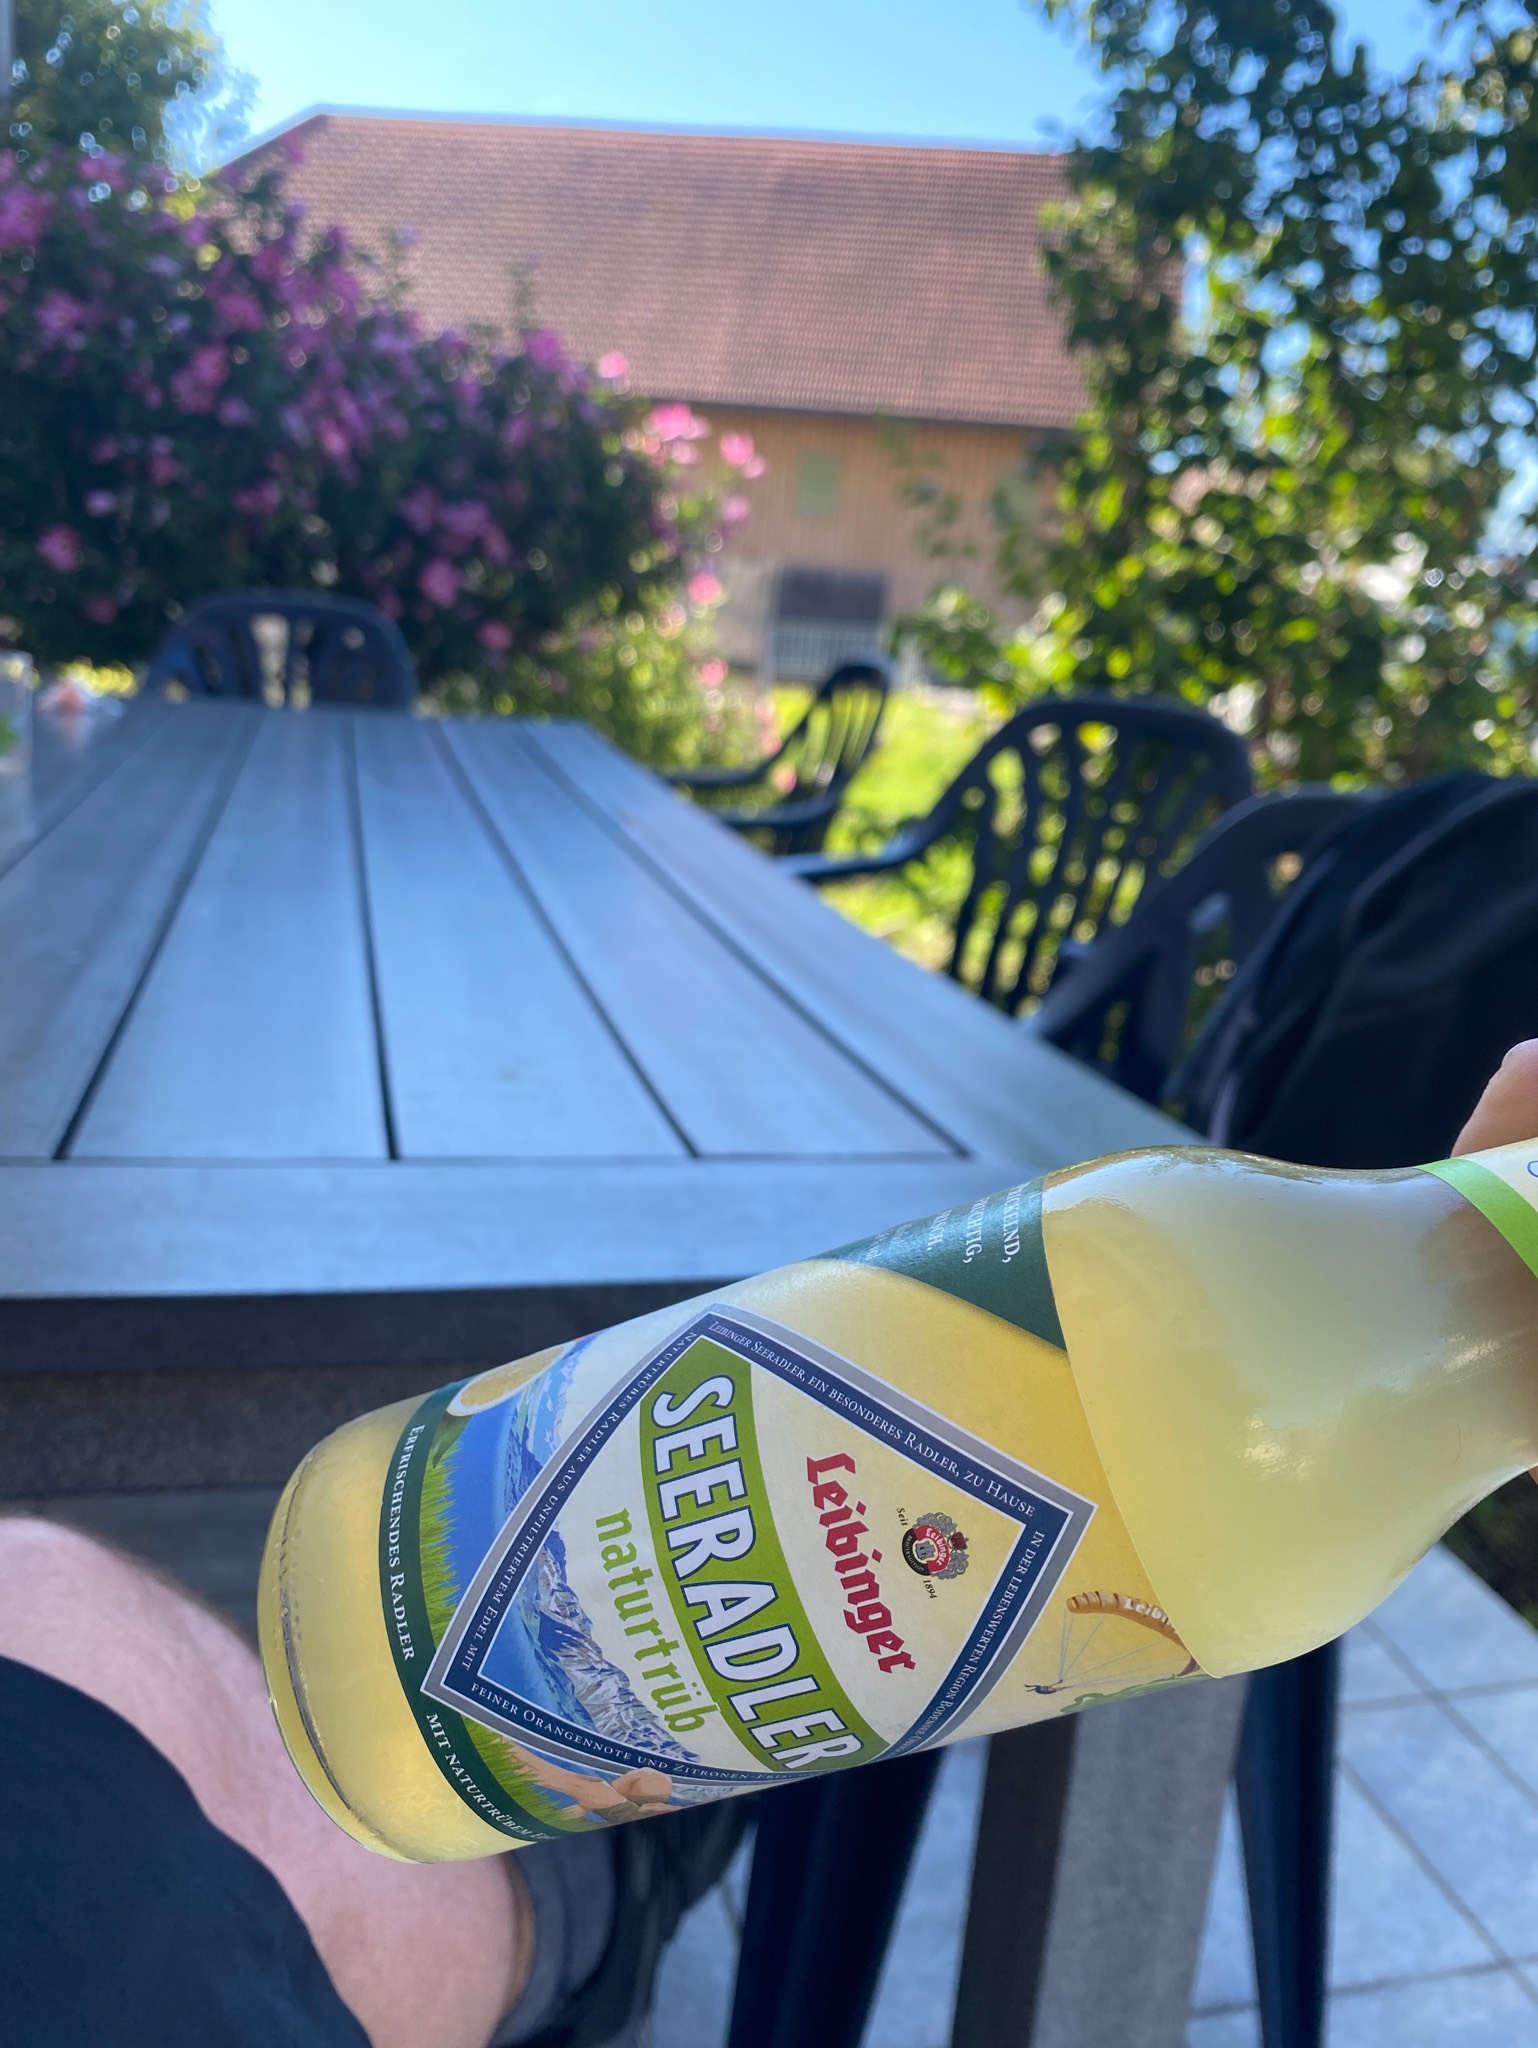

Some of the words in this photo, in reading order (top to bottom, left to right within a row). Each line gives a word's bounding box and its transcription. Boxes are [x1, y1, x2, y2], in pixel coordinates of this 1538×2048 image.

[618, 1331, 697, 1409] NATURTRÜBES
[576, 1411, 620, 1463] RADLER
[708, 1321, 752, 1348] LEIBINGER
[751, 1340, 806, 1382] SEERADLER,
[808, 1376, 829, 1393] EIN
[829, 1388, 903, 1440] BESONDERES
[904, 1431, 960, 1477] RADLER,
[963, 1470, 984, 1487] ZU
[986, 1480, 1036, 1518] HAUSE
[388, 1424, 426, 1569] ERFRISCHENDES
[557, 1464, 577, 1491] AUS
[493, 1495, 558, 1601] UNFILTRIERTEM
[651, 1374, 865, 1770] SEERADLER
[806, 1452, 917, 1674] Leibinger
[896, 1507, 909, 1527] Seit
[922, 1579, 938, 1600] 1894
[925, 1527, 947, 1566] Leibinger
[1017, 1548, 1037, 1575] DER
[1030, 1530, 1046, 1548] IN
[389, 1572, 415, 1661] RADLER
[461, 1642, 480, 1672] MIT
[473, 1605, 499, 1645] EDEL
[595, 1506, 719, 1733] naturtrüb
[968, 1577, 1022, 1668] LEBENSWERTEN
[946, 1663, 978, 1699] REGION
[471, 1682, 518, 1715] FEINER
[523, 1709, 632, 1760] ORANGENNOTE
[637, 1755, 669, 1770] UND
[426, 1712, 452, 1750] MIT
[444, 1752, 533, 1837] NATURTRÜBEM
